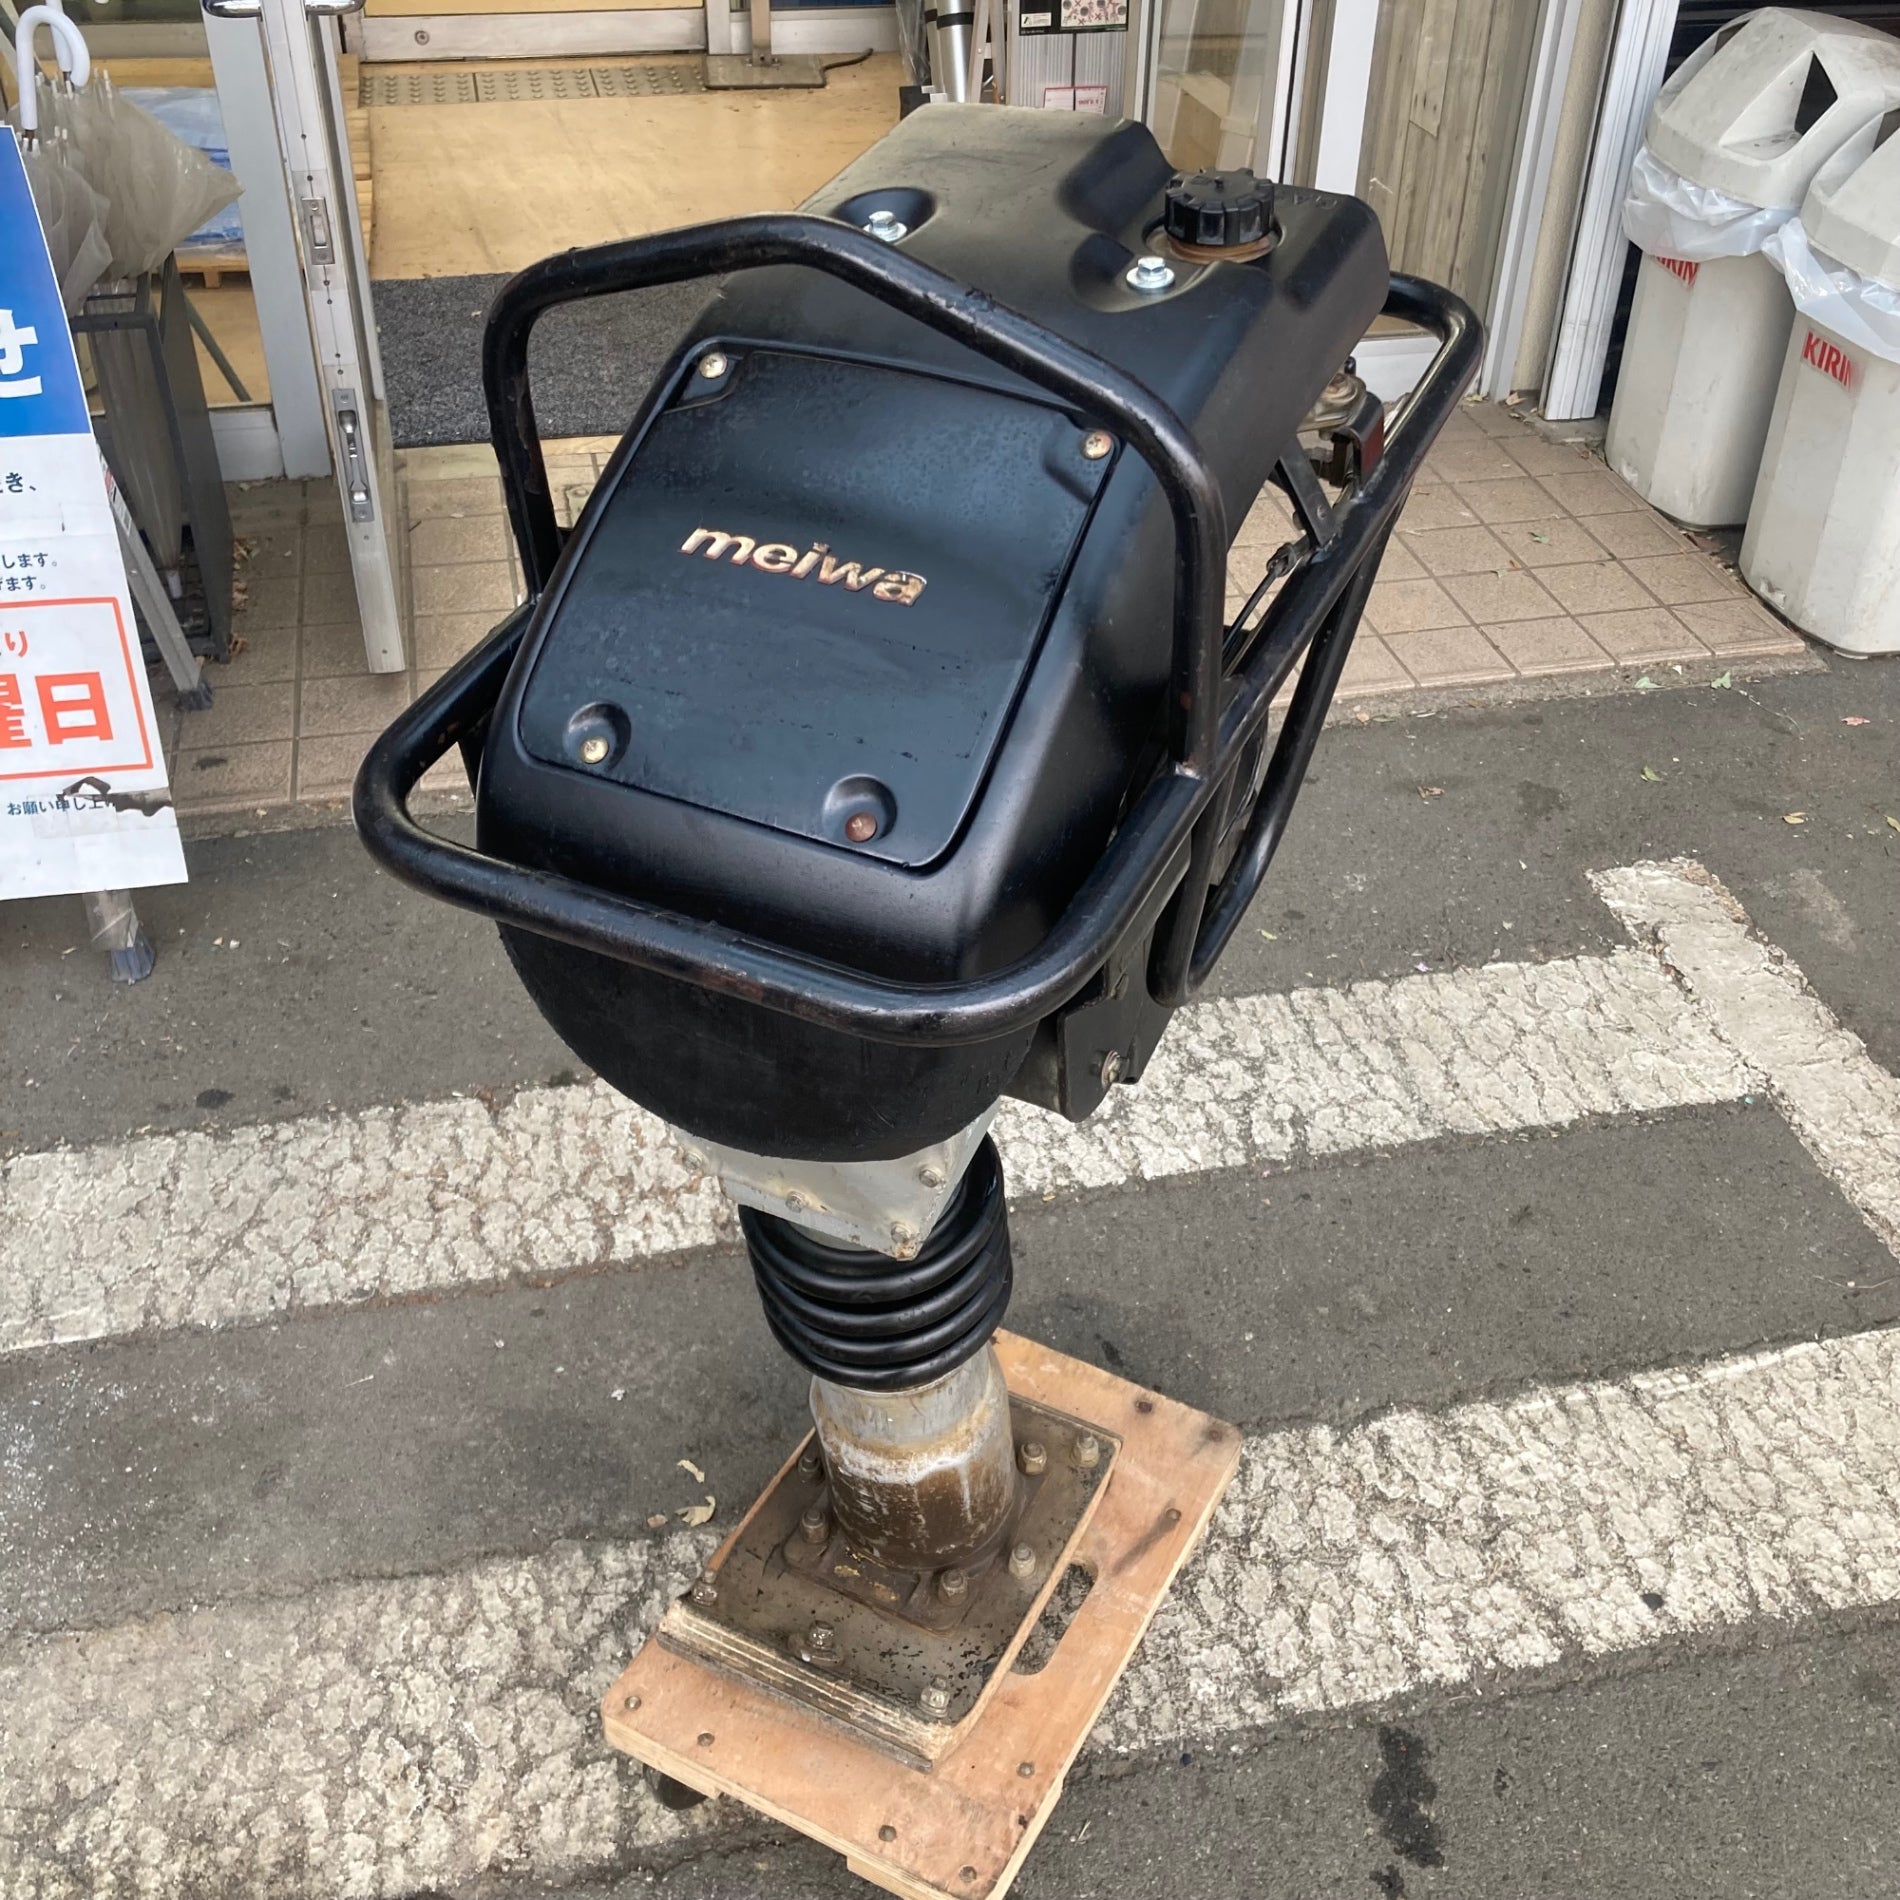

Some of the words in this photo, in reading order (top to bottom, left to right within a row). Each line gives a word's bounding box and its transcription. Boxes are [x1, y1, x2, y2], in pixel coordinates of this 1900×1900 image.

[0, 472, 37, 494] き、
[679, 527, 927, 607] meiwa
[0, 575, 46, 592] ます。
